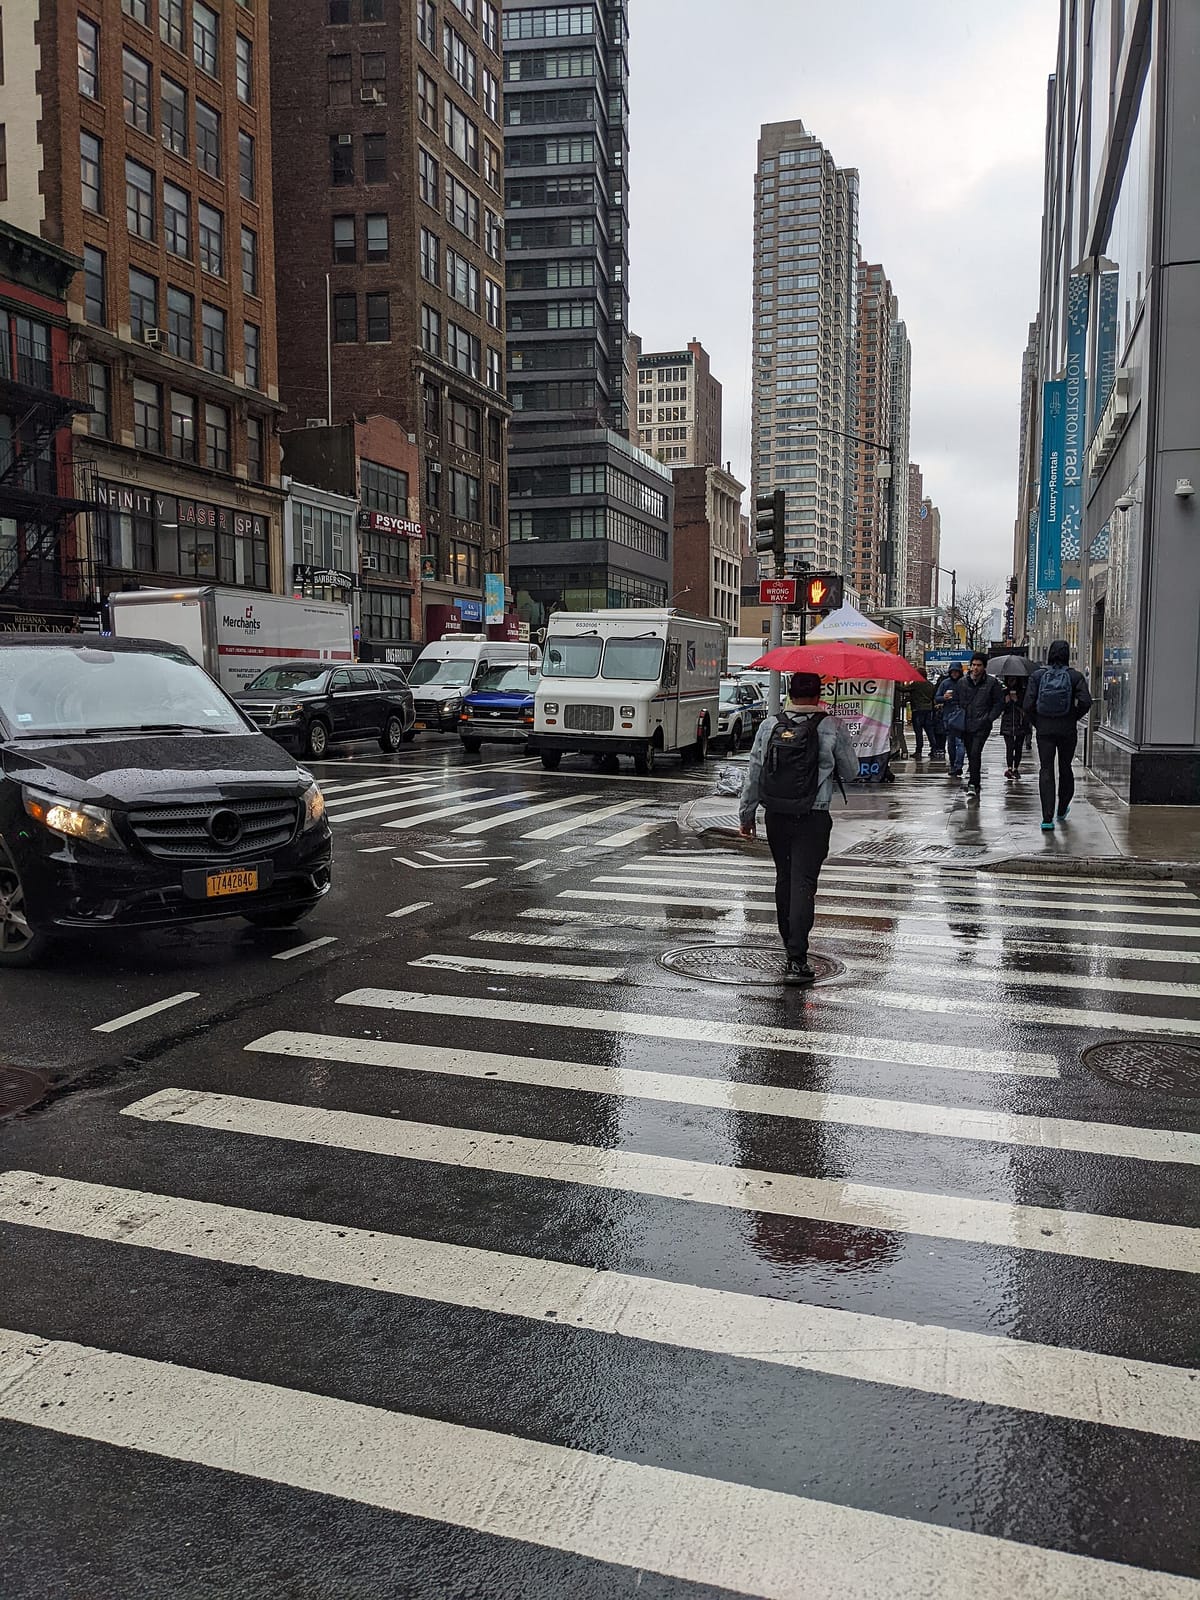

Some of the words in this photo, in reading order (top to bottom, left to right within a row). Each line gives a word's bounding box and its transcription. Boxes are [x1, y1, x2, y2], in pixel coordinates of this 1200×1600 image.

[1065, 353, 1081, 445] NORDSTROM
[1049, 451, 1058, 487] Rentals
[1064, 448, 1080, 486] rack
[92, 486, 165, 515] INFINITY
[178, 503, 226, 529] LASER
[237, 518, 261, 535] SPA
[1048, 488, 1058, 522] Luxury
[376, 514, 421, 533] PSYCHIC
[314, 574, 352, 589] BARBERSHOP
[0, 622, 50, 633] OSMETICS
[223, 615, 261, 630] Merchants
[820, 679, 878, 697] ESTING
[211, 872, 253, 892] T744284C
